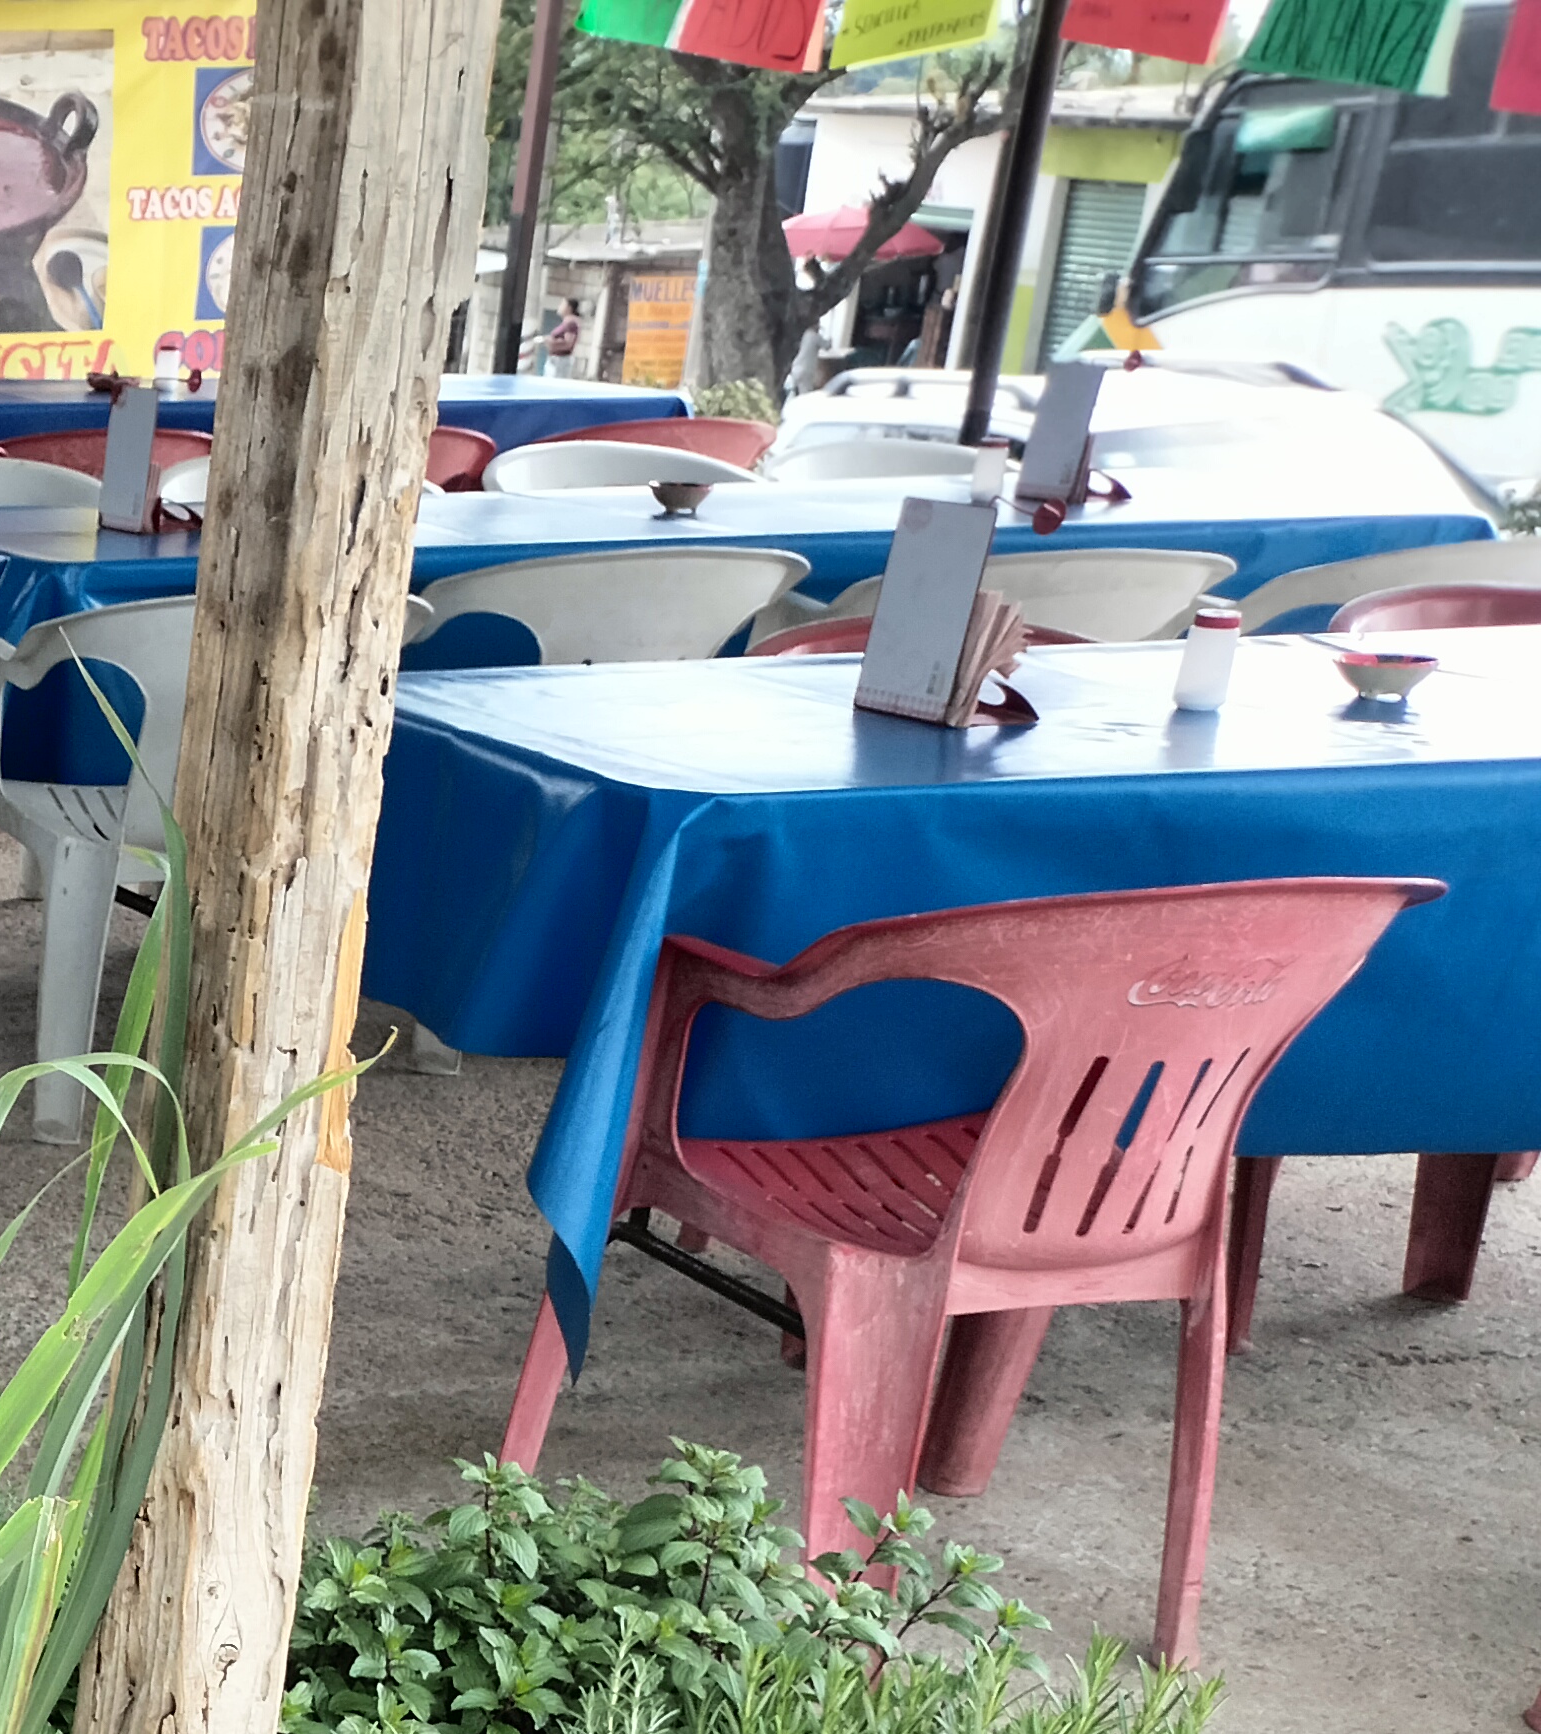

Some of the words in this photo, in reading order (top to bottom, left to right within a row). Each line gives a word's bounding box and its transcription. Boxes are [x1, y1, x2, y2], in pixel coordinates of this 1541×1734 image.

[141, 15, 245, 62] TACOS
[126, 185, 214, 221] TACOS
[213, 184, 242, 219] A
